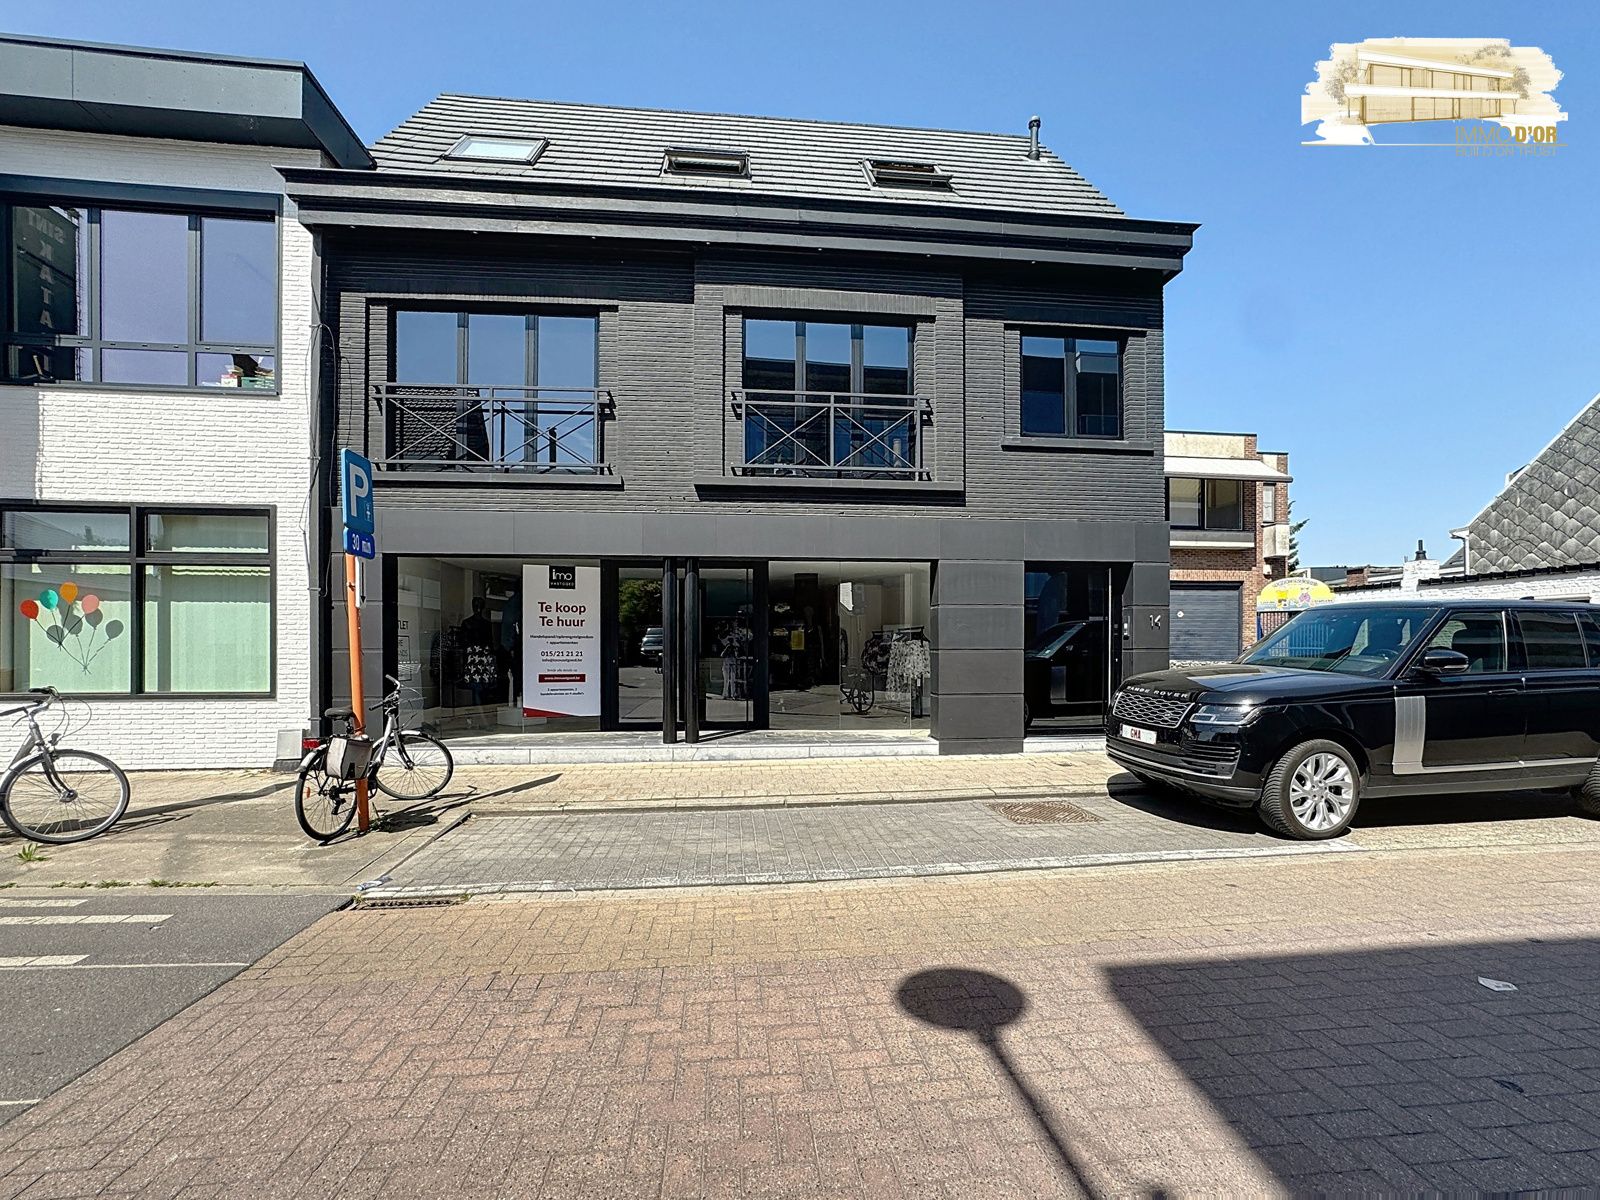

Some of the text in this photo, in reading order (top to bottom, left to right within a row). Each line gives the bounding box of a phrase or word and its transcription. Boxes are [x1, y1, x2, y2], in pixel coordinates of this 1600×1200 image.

[349, 462, 369, 517] P
[352, 533, 360, 551] 30
[538, 602, 586, 615] Te koop
[539, 616, 586, 627] Te huur
[1149, 614, 1161, 628] 14
[1126, 685, 1189, 699] RANGE ROVER
[1130, 729, 1141, 740] GMA
